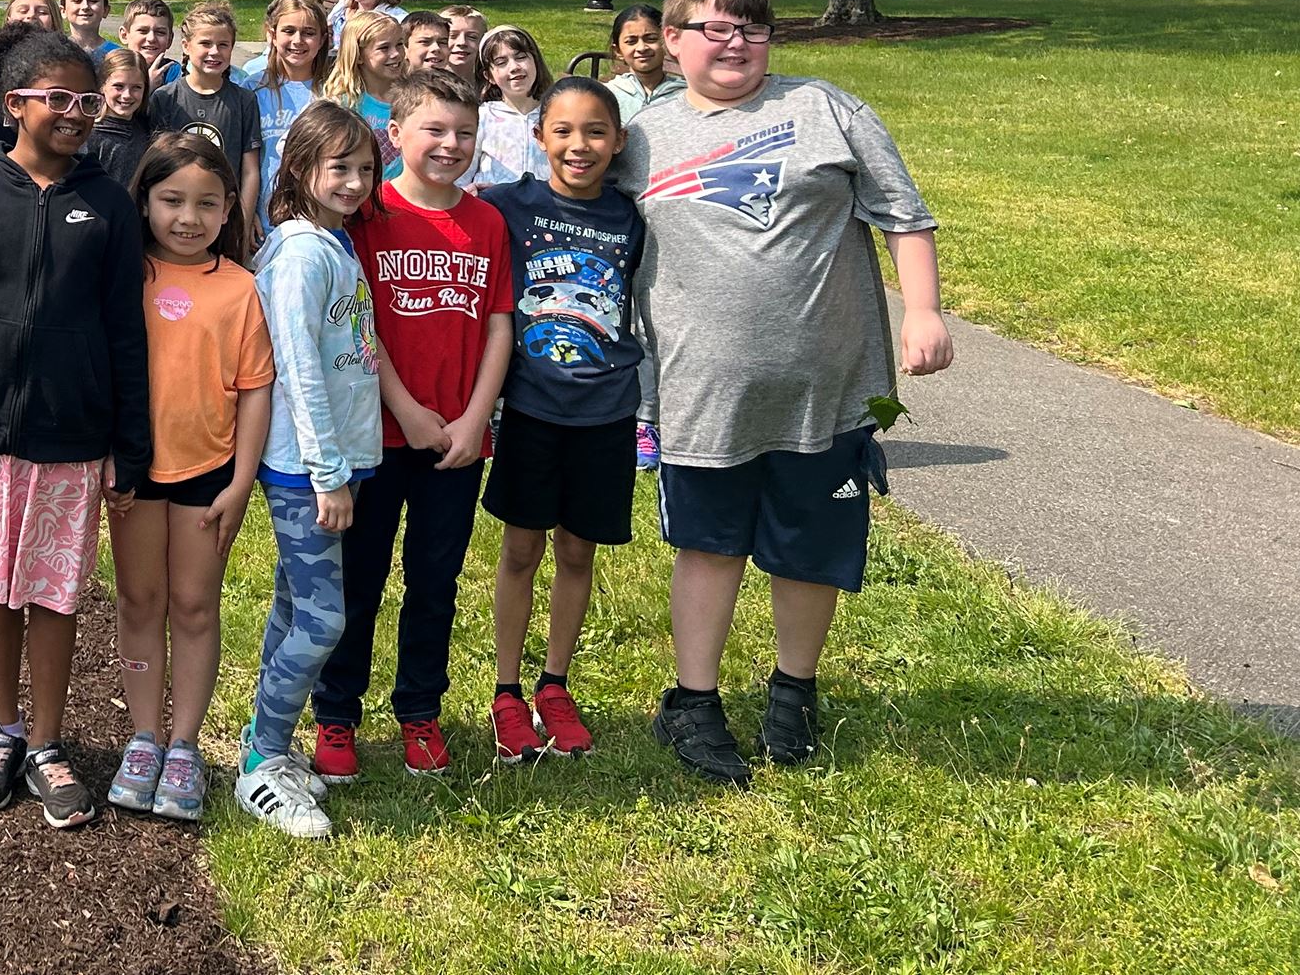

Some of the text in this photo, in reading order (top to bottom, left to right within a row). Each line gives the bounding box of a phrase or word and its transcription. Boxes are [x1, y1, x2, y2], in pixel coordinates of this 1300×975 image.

[736, 119, 795, 148] PATRIOTS
[534, 216, 549, 229] THE
[549, 220, 582, 236] EARTH'S
[376, 249, 490, 288] NORTH
[397, 291, 434, 310] Fun
